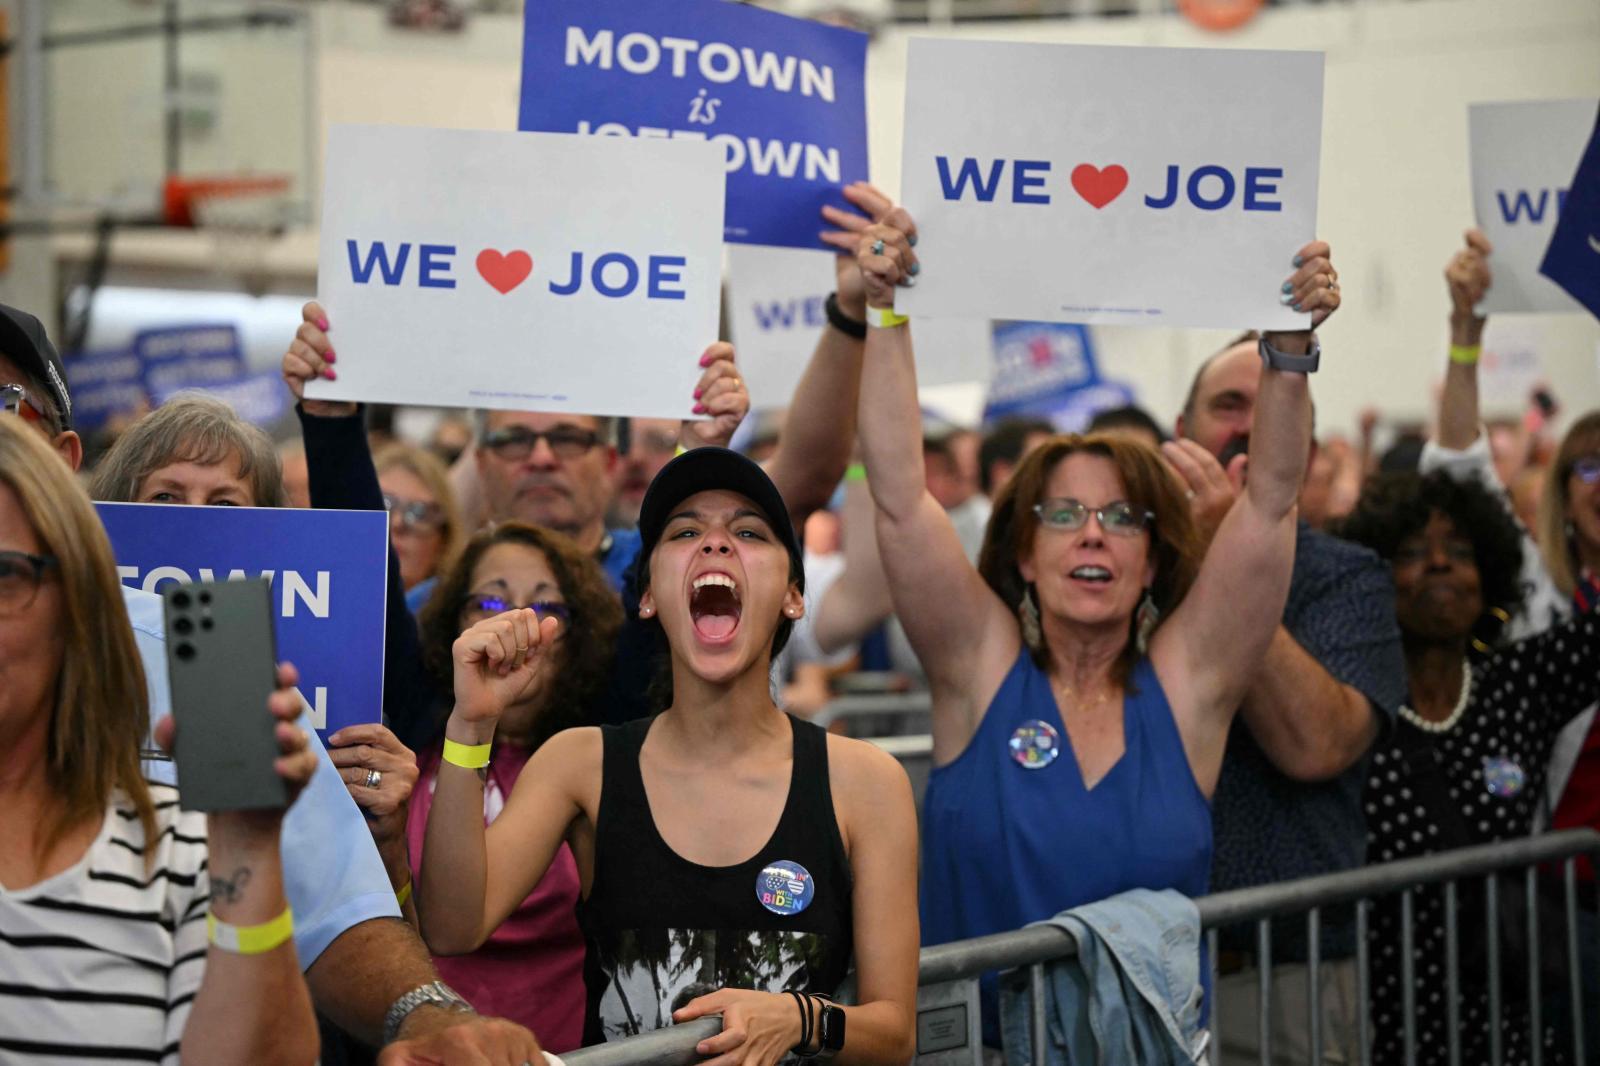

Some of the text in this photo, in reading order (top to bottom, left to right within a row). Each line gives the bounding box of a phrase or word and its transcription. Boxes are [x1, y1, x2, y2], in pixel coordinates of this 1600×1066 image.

[565, 26, 835, 102] MOTOWN
[688, 89, 721, 125] is
[936, 156, 1284, 212] WE JOE
[347, 239, 686, 300] WE JOE
[762, 892, 803, 911] BIDEN
[776, 889, 793, 897] WITH
